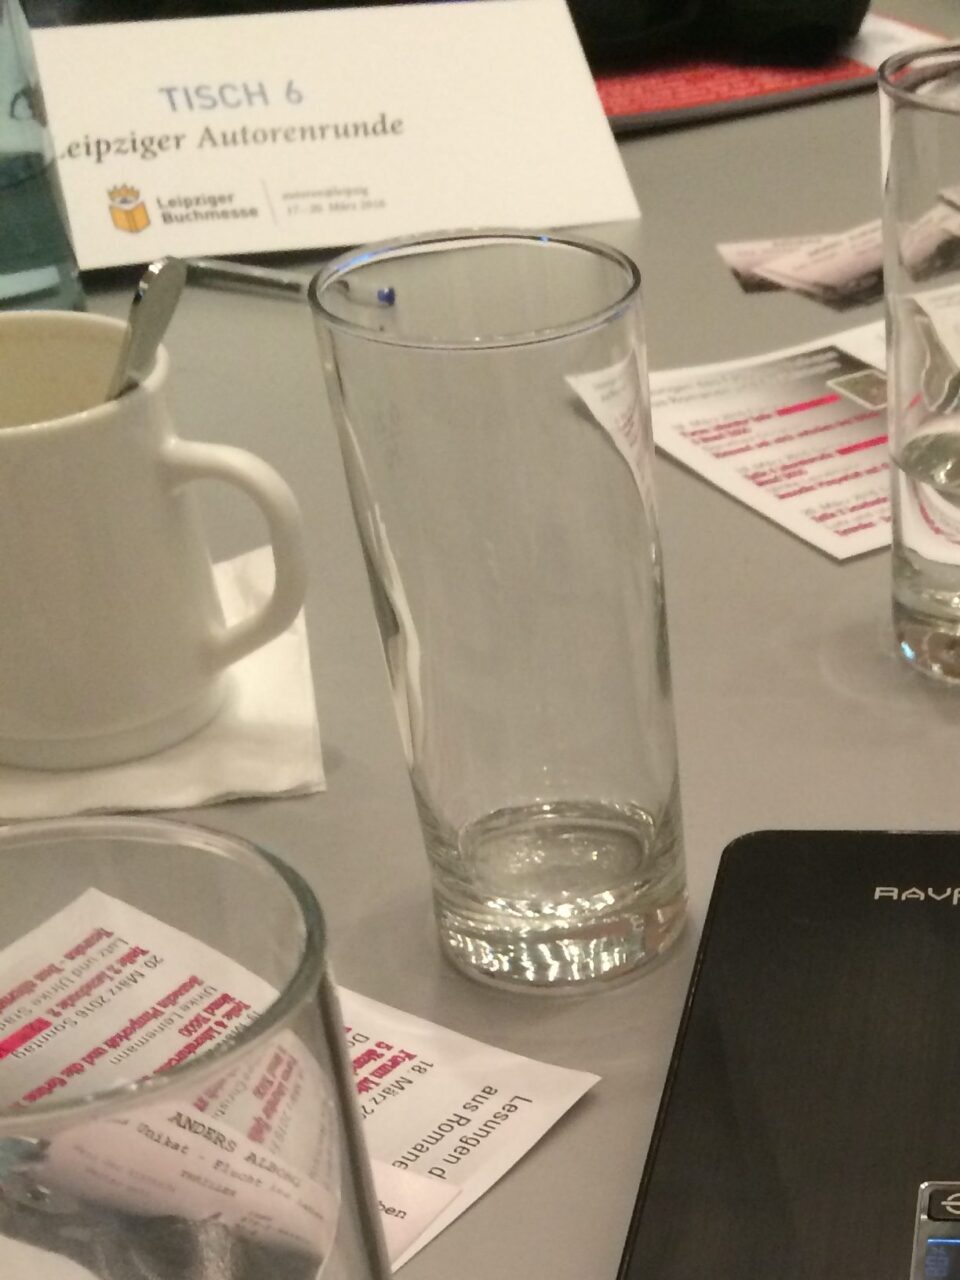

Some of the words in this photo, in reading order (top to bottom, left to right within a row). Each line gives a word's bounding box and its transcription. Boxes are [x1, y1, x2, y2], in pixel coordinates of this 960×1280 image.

[159, 82, 270, 113] TISCH
[286, 80, 303, 105] 6
[59, 131, 186, 164] eipziger
[197, 113, 405, 150] Autorenrunde
[156, 193, 235, 211] Leipziger
[161, 206, 259, 225] Buchmesse
[74, 994, 110, 1020] 2016
[179, 985, 216, 1011] Ulrike
[9, 1017, 78, 1061] Sonntag
[109, 1011, 183, 1065] Leinemann
[368, 1076, 413, 1105] März
[462, 1084, 498, 1112] aus
[136, 1122, 189, 1156] Unikat
[167, 1110, 237, 1154] ANDERS
[442, 1095, 532, 1166] Lesungen
